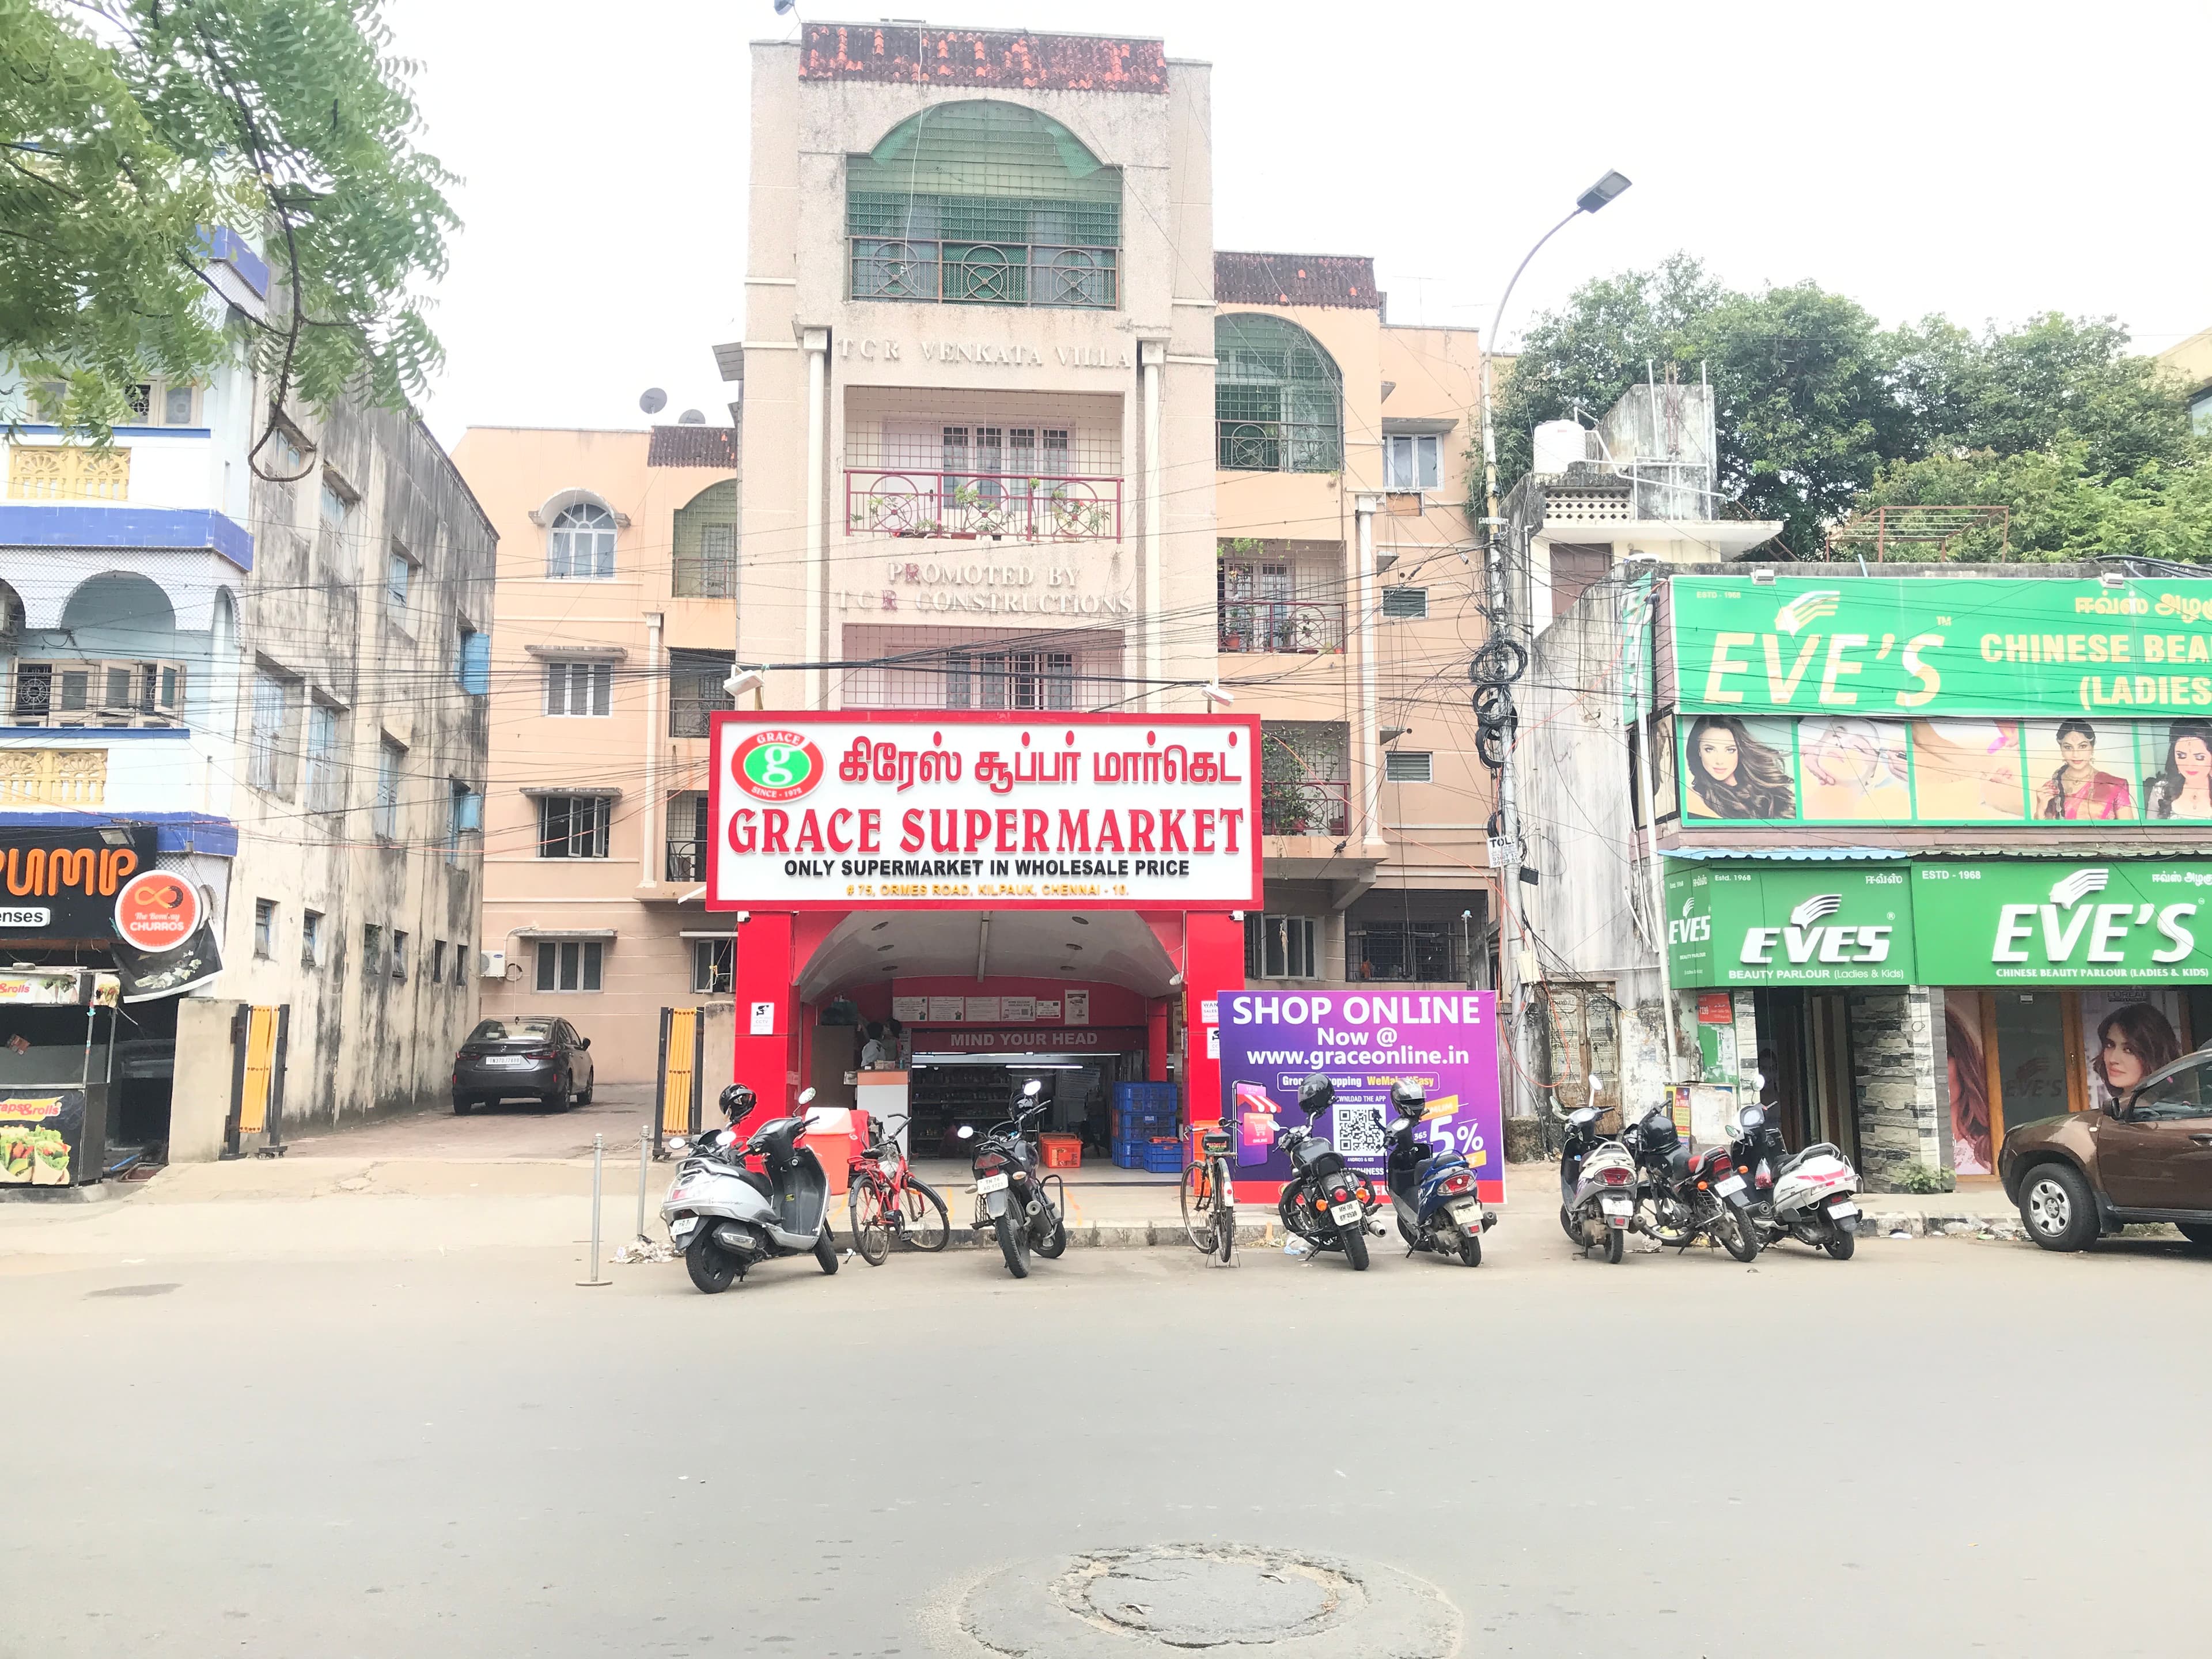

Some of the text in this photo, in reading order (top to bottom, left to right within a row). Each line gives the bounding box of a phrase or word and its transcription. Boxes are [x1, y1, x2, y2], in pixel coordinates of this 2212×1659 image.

[922, 340, 1043, 366] VENKATA
[1055, 346, 1131, 368] VILLA
[889, 562, 1077, 586] PROMOTED BY
[915, 590, 1132, 613] CONSTRUCTIONS
[1980, 634, 2212, 663] CHINESE BEA
[1703, 632, 1946, 707] EVE'S
[756, 732, 800, 745] GRACE
[839, 730, 1242, 794] கிரேஸ் சூப்பர் மார்கெட்
[751, 786, 777, 798] SINCE
[785, 787, 802, 798] 1972
[728, 808, 1244, 854] GRACE SUPERMARKET
[785, 859, 1190, 876] ONLY SUPERMARKET IN WHOLESALE PRICE
[1922, 870, 1949, 880] ESTD
[1959, 870, 1981, 880] 1968
[880, 884, 927, 895] ORMES
[932, 884, 974, 896] ROAD,
[977, 884, 1037, 896] KILPAUK,
[1041, 884, 1101, 895] CHENNAI
[0, 912, 43, 922] nses
[130, 922, 184, 931] CHURROS
[1668, 915, 1711, 945] EVES
[1991, 903, 2197, 963] EVE'S
[1740, 926, 1892, 963] EVES
[1729, 970, 1774, 979] BEAUTY
[1777, 970, 1830, 979] PARLOUR
[1834, 969, 1870, 979] (Ladies
[1882, 969, 1904, 979] Kids)
[1996, 969, 2037, 977] CHINESE
[2040, 969, 2079, 977] BEAUTY
[2081, 969, 2127, 977] PARLOUR
[2130, 968, 2169, 978] (LADIES
[2182, 968, 2209, 978] KIDS)
[1233, 997, 1480, 1025] SHOP ONLINE
[950, 1032, 1097, 1046] MIND YOUR HEAD
[1317, 1027, 1397, 1047] Now @
[1247, 1045, 1469, 1070] www.graceonline.in
[0, 1104, 59, 1115] aps&rolls
[1414, 1131, 1427, 1141] 365
